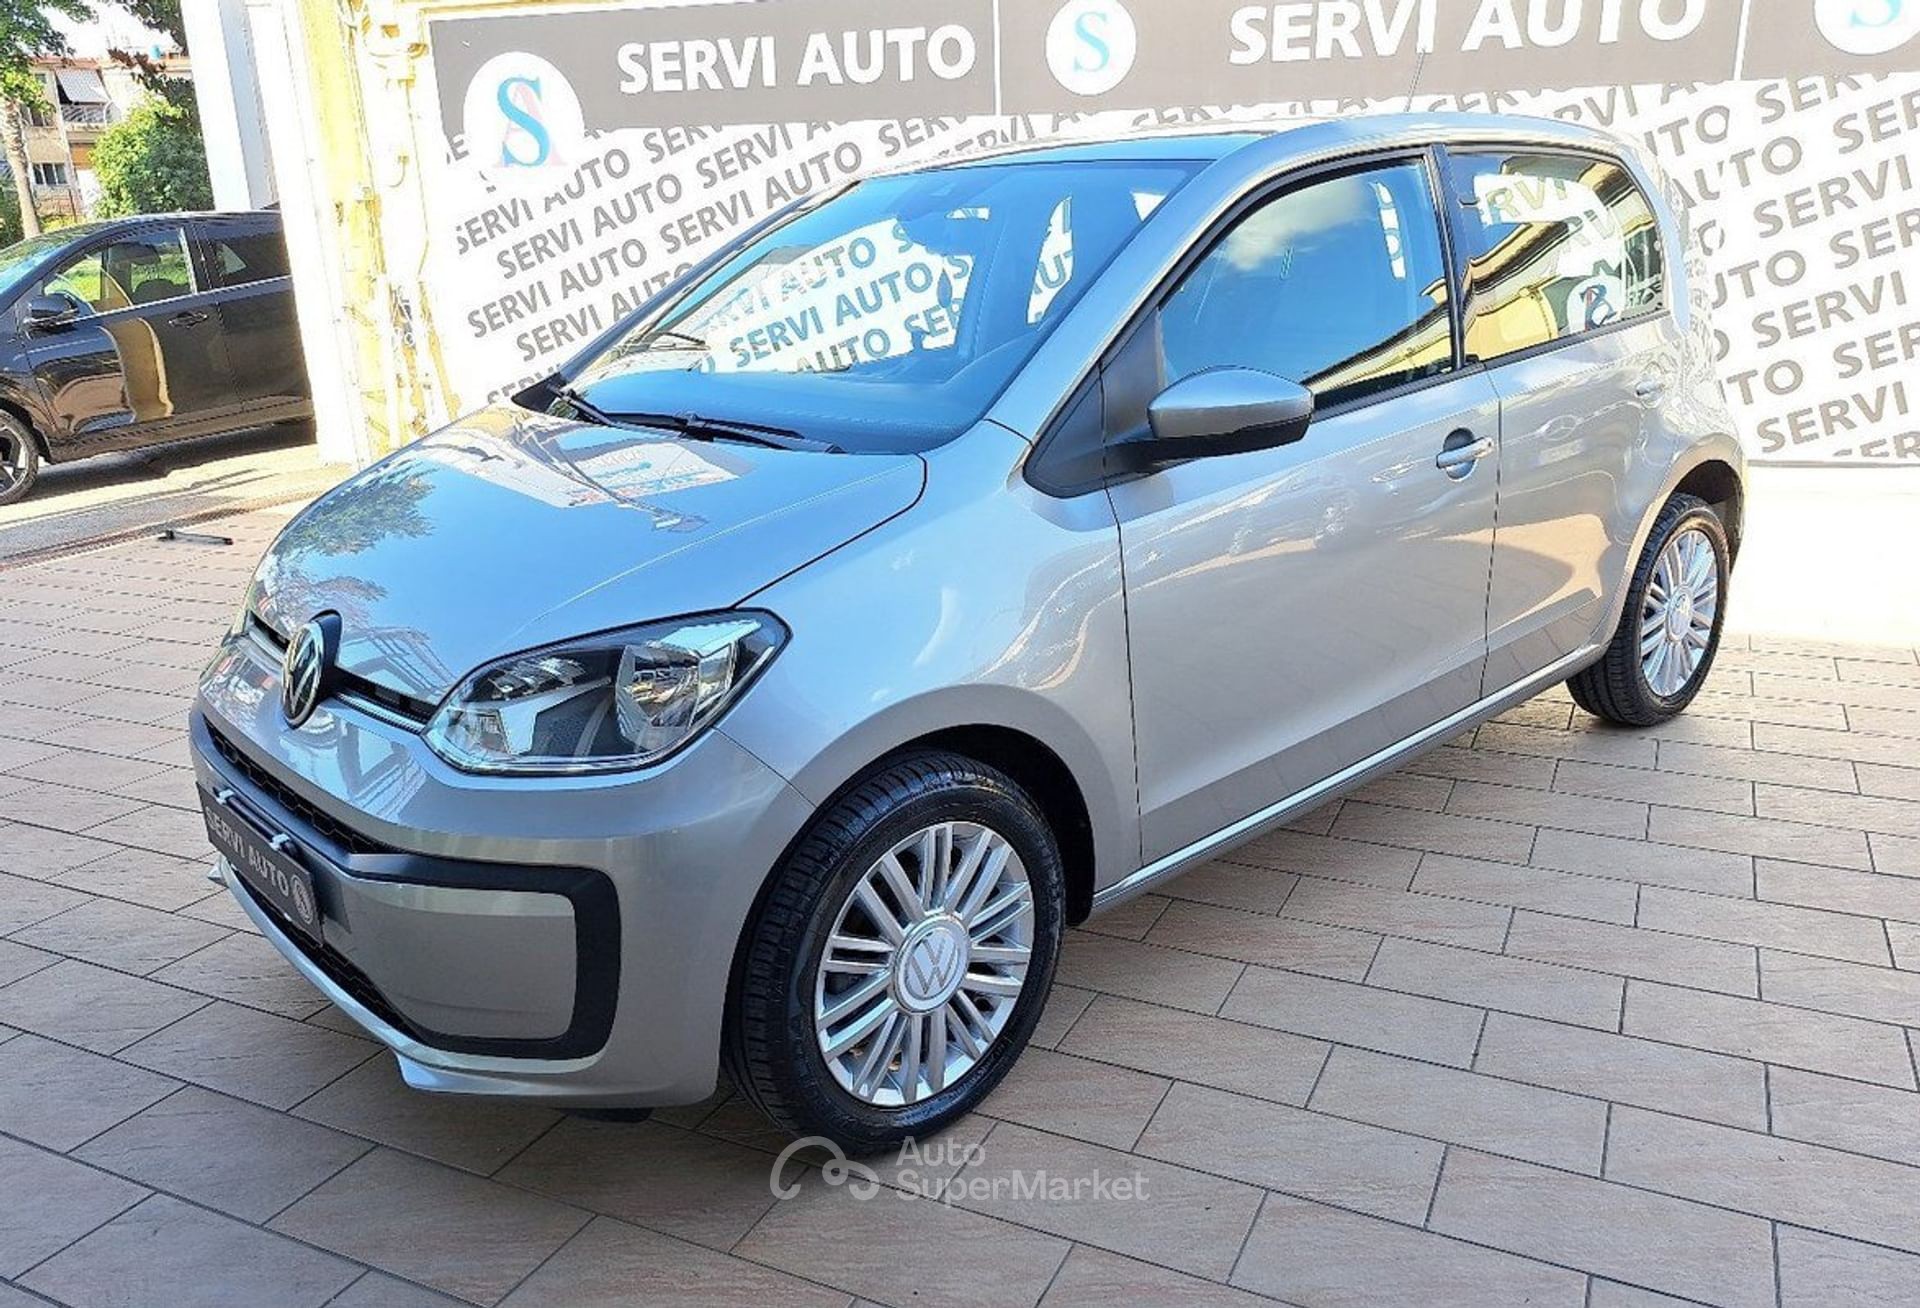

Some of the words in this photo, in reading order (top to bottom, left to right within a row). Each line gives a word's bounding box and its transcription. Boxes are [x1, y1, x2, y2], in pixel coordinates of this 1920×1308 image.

[616, 35, 777, 95] SERVI
[796, 24, 977, 85] AUTO
[1228, 0, 1437, 66] SERVI
[1461, 0, 1706, 51] AUTO
[497, 218, 584, 280] SERVI
[593, 173, 682, 238] AUTO
[696, 122, 794, 189] SERVI
[1753, 154, 1913, 240] SERVI
[467, 281, 553, 338] SERVI
[559, 238, 648, 300] AUTO
[659, 190, 755, 254] SERVI
[764, 142, 863, 210] AUTO
[516, 303, 602, 363] SERVI
[729, 305, 824, 368] SERVI
[835, 262, 934, 327] AUTO
[1751, 270, 1908, 350] SERVI
[1757, 381, 1909, 453] SERVI
[204, 805, 248, 859] SERVI
[248, 844, 289, 898] AUTO
